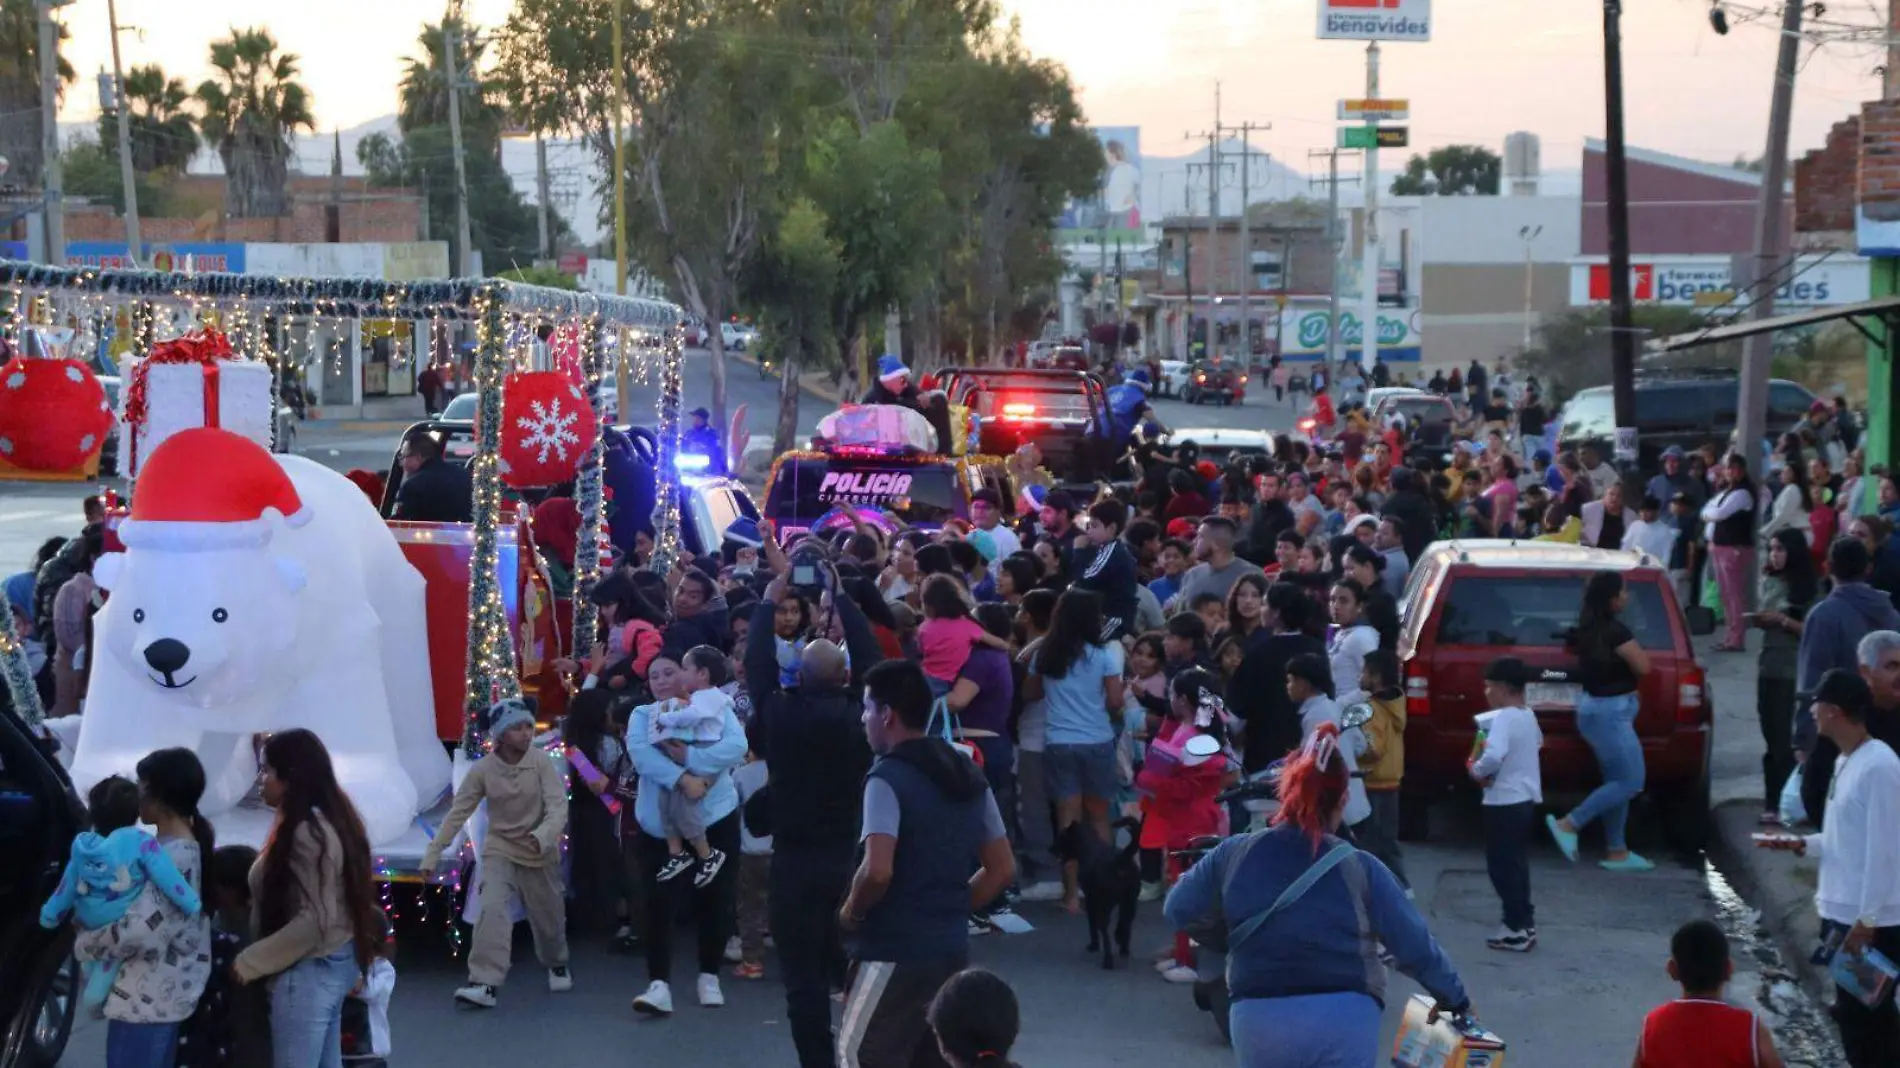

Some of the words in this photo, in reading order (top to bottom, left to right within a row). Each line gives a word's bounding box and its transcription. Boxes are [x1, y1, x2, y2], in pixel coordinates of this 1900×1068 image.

[1327, 15, 1428, 34] benavides
[819, 471, 913, 495] POLICÍA
[1541, 669, 1568, 680] Jeep
